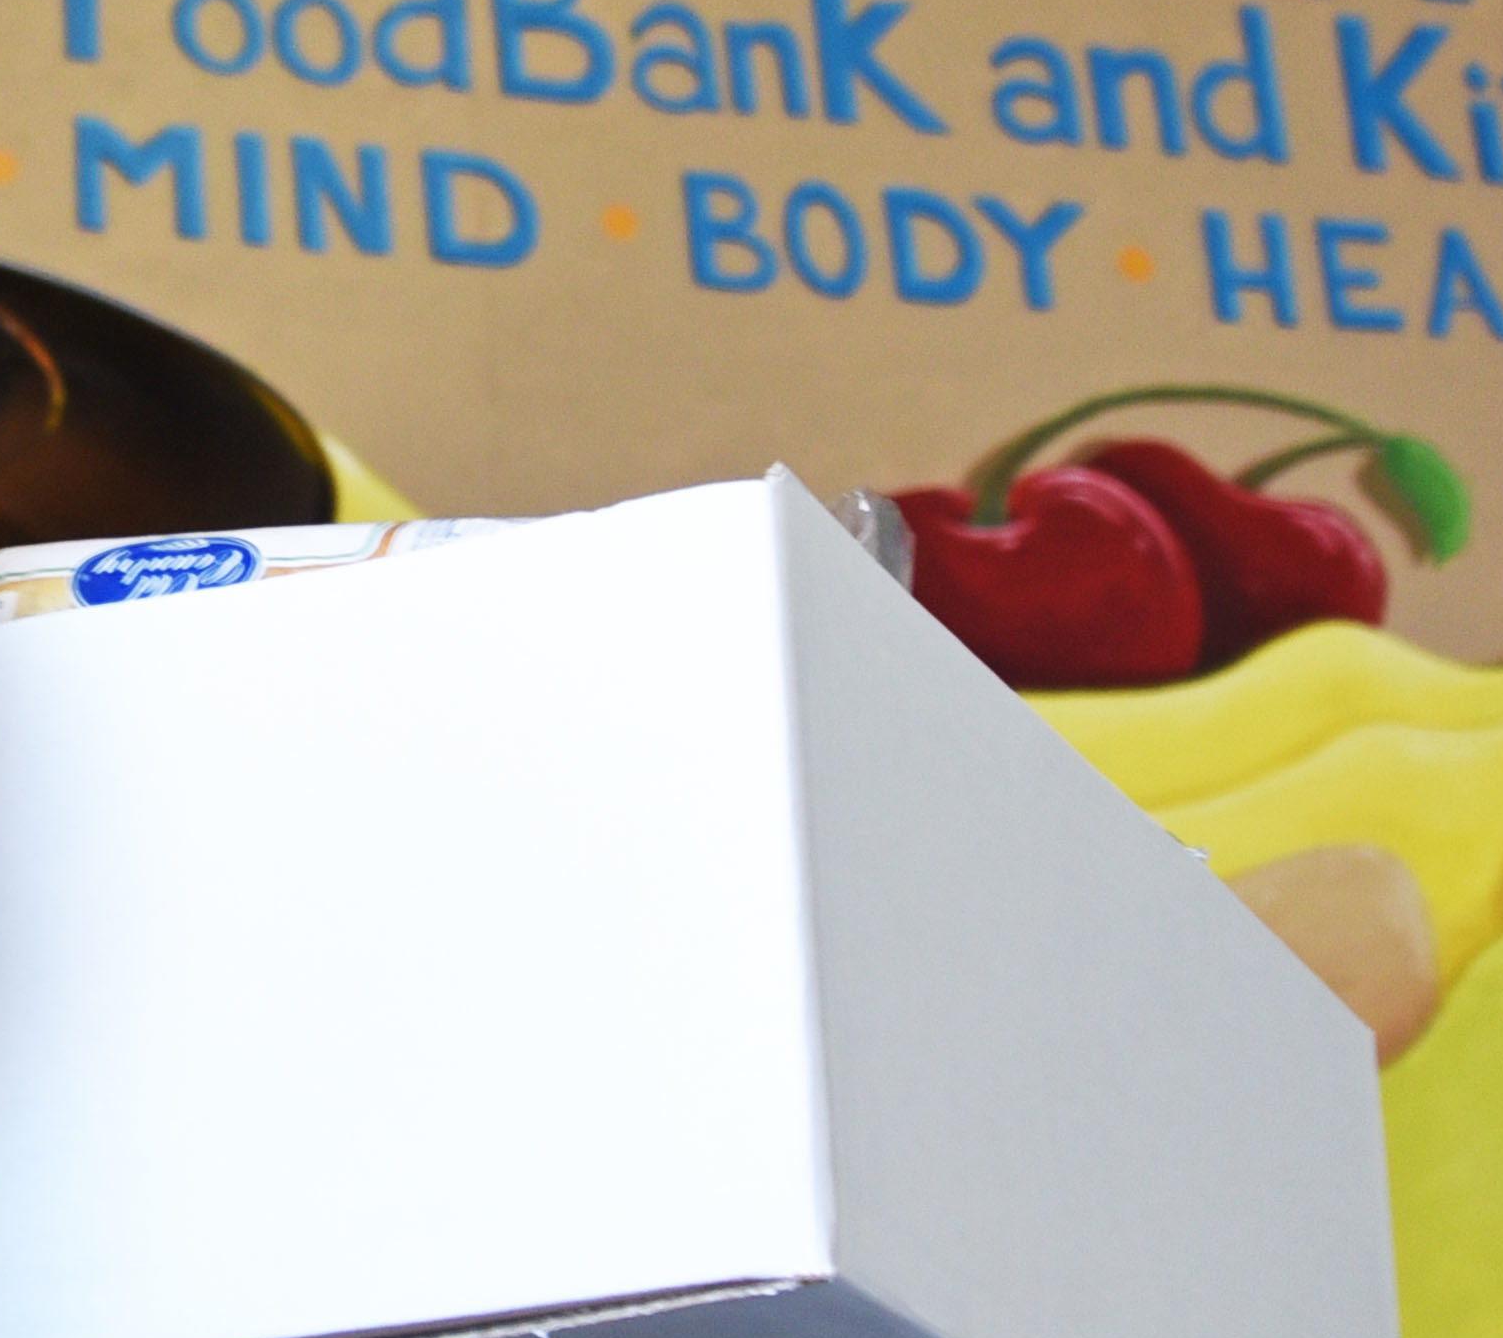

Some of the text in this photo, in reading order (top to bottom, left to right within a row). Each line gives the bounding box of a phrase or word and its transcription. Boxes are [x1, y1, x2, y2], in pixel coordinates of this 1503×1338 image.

[993, 5, 1288, 165] and
[74, 117, 540, 269] MIND
[682, 169, 1083, 312] BODY
